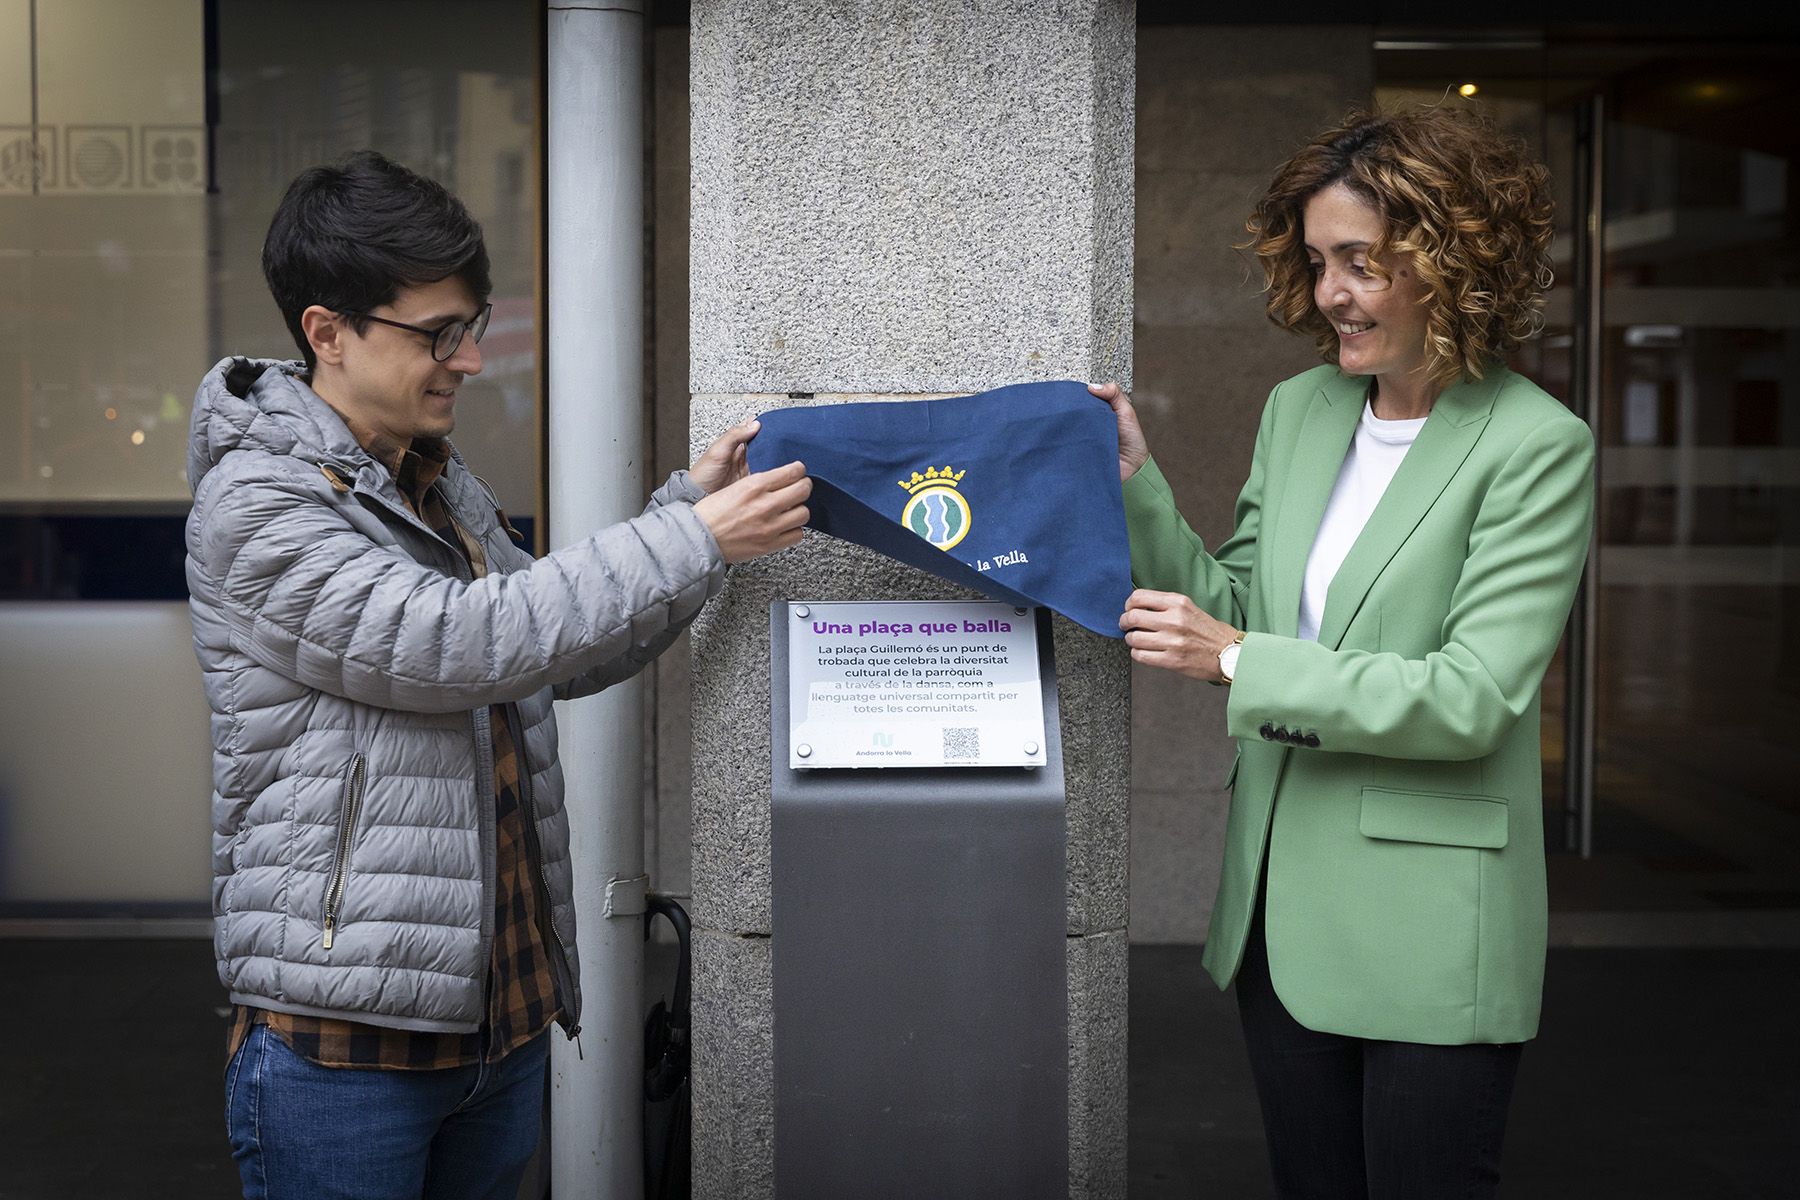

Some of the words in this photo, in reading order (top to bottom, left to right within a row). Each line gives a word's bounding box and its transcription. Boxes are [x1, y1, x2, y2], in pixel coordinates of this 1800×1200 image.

[977, 560, 991, 572] la
[993, 550, 1028, 568] Vella
[813, 622, 853, 634] Una
[859, 621, 913, 636] plaça
[919, 621, 957, 635] que
[964, 620, 1012, 633] balla
[818, 646, 832, 654] La
[835, 645, 867, 656] plaça
[870, 644, 923, 653] Guillemó
[926, 644, 939, 653] és
[961, 645, 989, 655] punt
[992, 644, 1007, 653] de
[818, 657, 864, 665] trobada
[867, 658, 890, 667] que
[893, 656, 937, 665] celebra
[940, 656, 950, 665] la
[954, 655, 1009, 665] diversitat
[845, 669, 891, 677] cultural
[894, 668, 909, 677] de
[912, 668, 922, 677] la
[925, 668, 983, 679] parròquia
[845, 680, 881, 689] través
[883, 680, 899, 689] de
[902, 680, 913, 688] la
[916, 680, 954, 690] dansa,
[811, 693, 876, 703] llenguatge
[879, 692, 933, 701] universal
[936, 692, 995, 703] compartit
[998, 693, 1018, 702] per
[854, 705, 884, 713] totes
[886, 704, 904, 713] les
[906, 704, 978, 713] comunitats.
